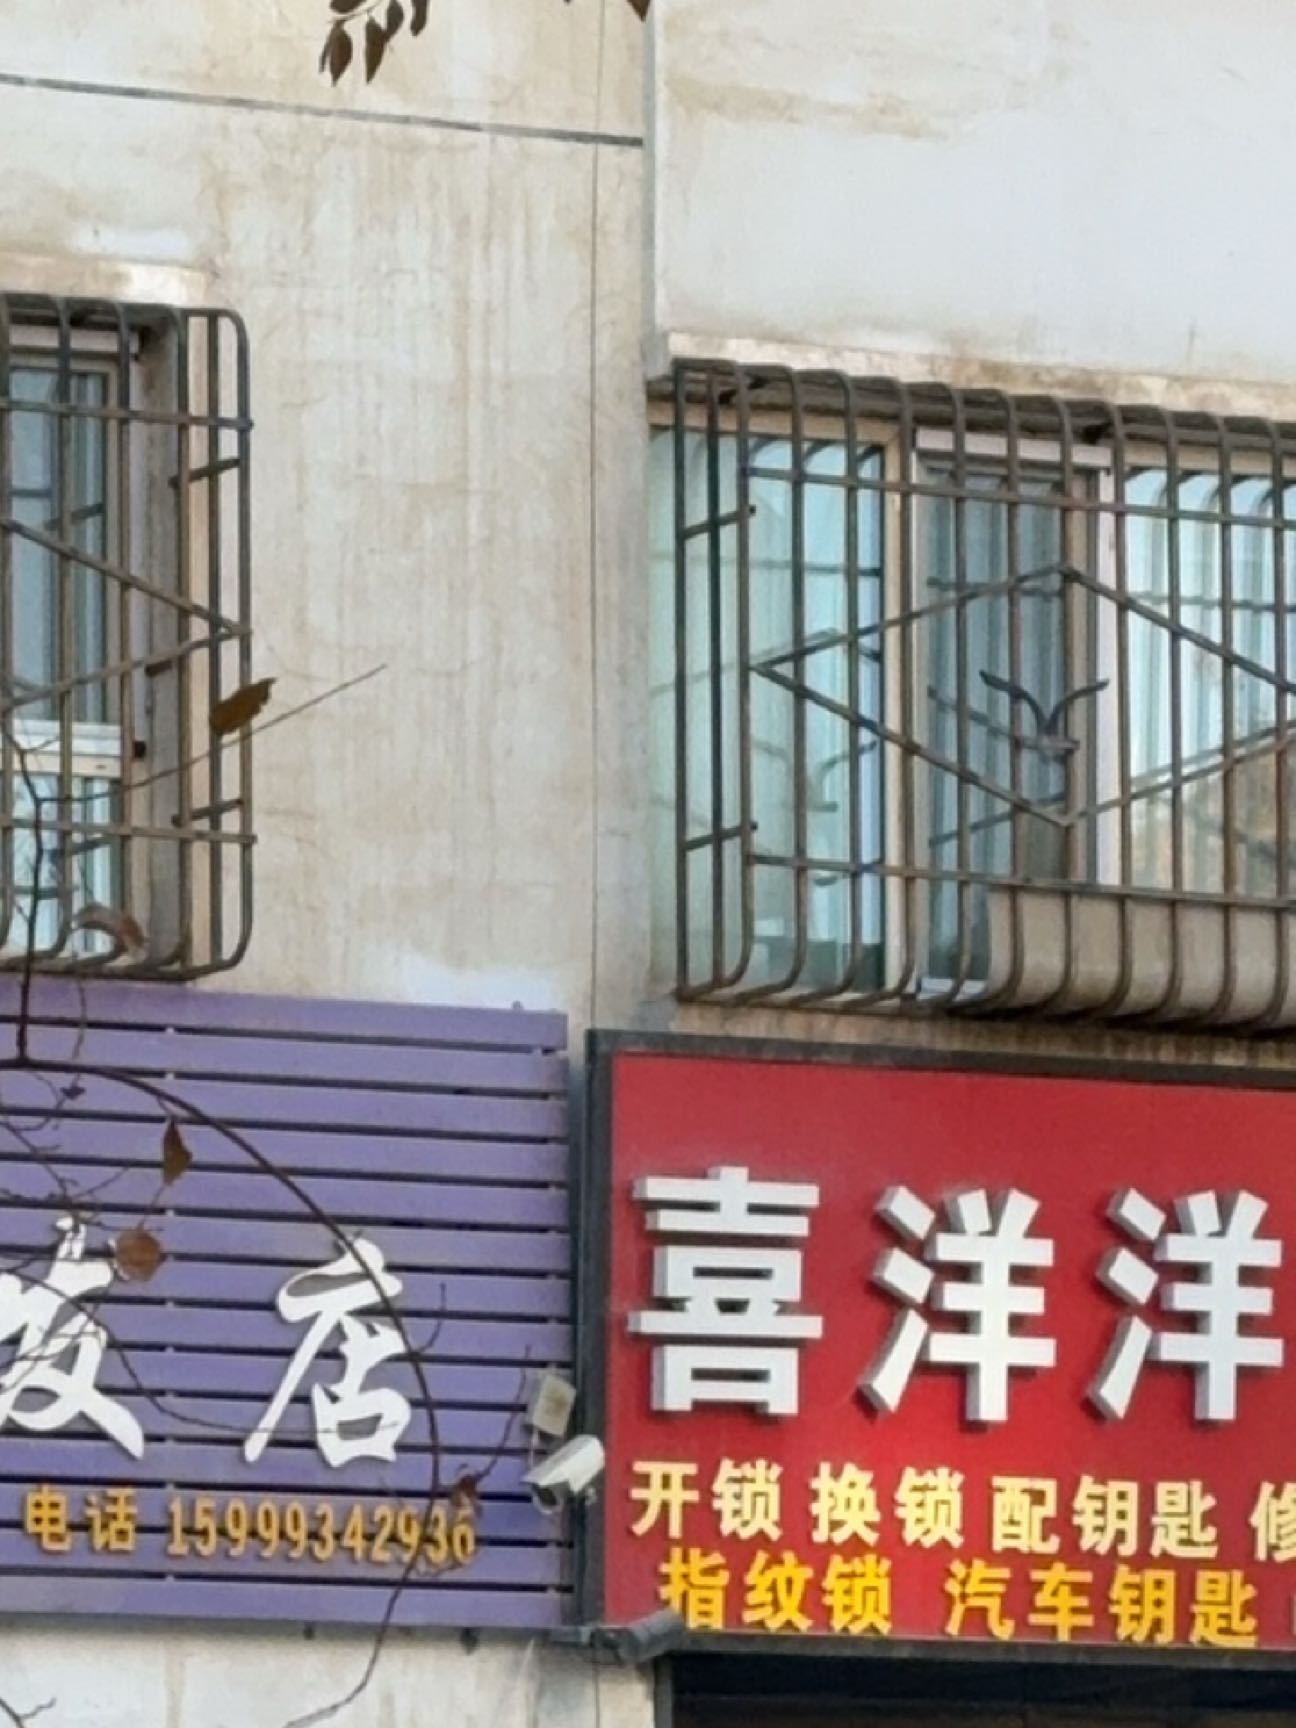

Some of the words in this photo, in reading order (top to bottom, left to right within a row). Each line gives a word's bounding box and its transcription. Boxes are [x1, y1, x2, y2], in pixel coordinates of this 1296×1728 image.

[628, 1166, 1284, 1421] 喜洋洋
[26, 1483, 138, 1553] 电话
[630, 1458, 783, 1542] 开锁
[810, 1462, 965, 1547] 换锁
[992, 1475, 1218, 1559] 配钥匙
[659, 1547, 893, 1637] 指纹锁
[942, 1560, 1259, 1648] 汽车钥匙
